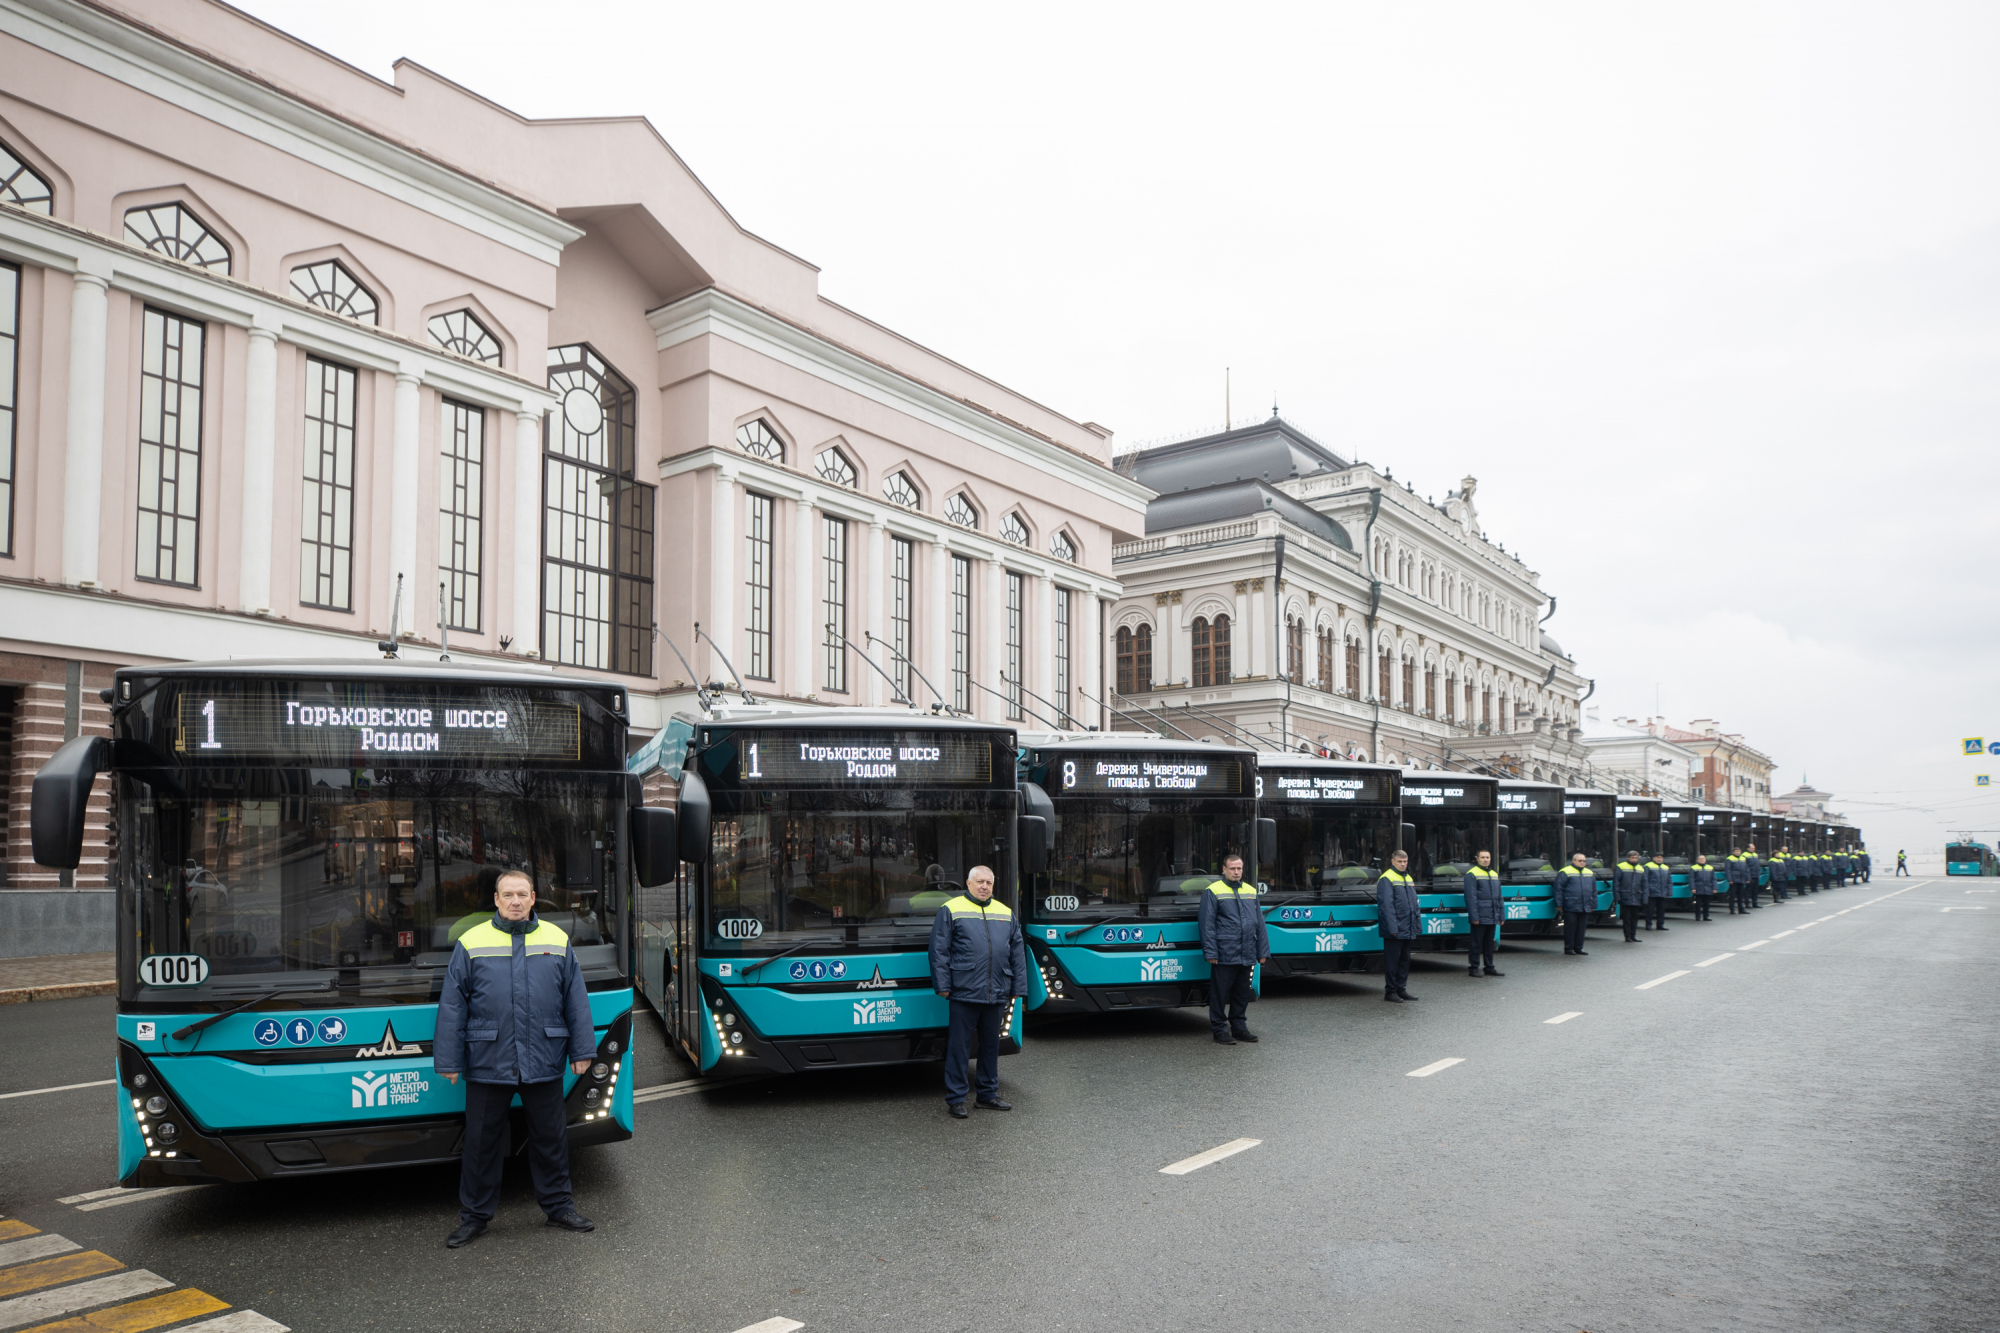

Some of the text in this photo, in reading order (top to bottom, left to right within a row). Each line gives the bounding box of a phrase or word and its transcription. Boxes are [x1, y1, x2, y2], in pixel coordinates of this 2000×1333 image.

[286, 701, 508, 728] Горьковское шоссе
[200, 700, 222, 748] 1
[360, 728, 439, 751] Роддом
[800, 744, 940, 761] Горьковское шоссе
[749, 743, 762, 777] 1
[847, 761, 897, 778] Роддом
[1063, 761, 1076, 787] 8
[1095, 762, 1207, 776] Деревня Универсиады
[1108, 776, 1197, 789] площадь Свободы
[1278, 777, 1363, 789] Деревня Универсиады
[1287, 788, 1355, 799] площадь Свободы
[1047, 896, 1075, 910] 1003
[721, 919, 758, 938] 1002
[147, 957, 202, 983] 1001
[877, 999, 896, 1008] МЕТРО
[877, 1007, 901, 1016] ЭЛЕКТРО
[877, 1015, 896, 1023] ТРАНС
[389, 1071, 419, 1084] МЕТРО
[389, 1081, 429, 1094] ЭЛЕКТРО
[389, 1092, 419, 1105] ТРАНС
